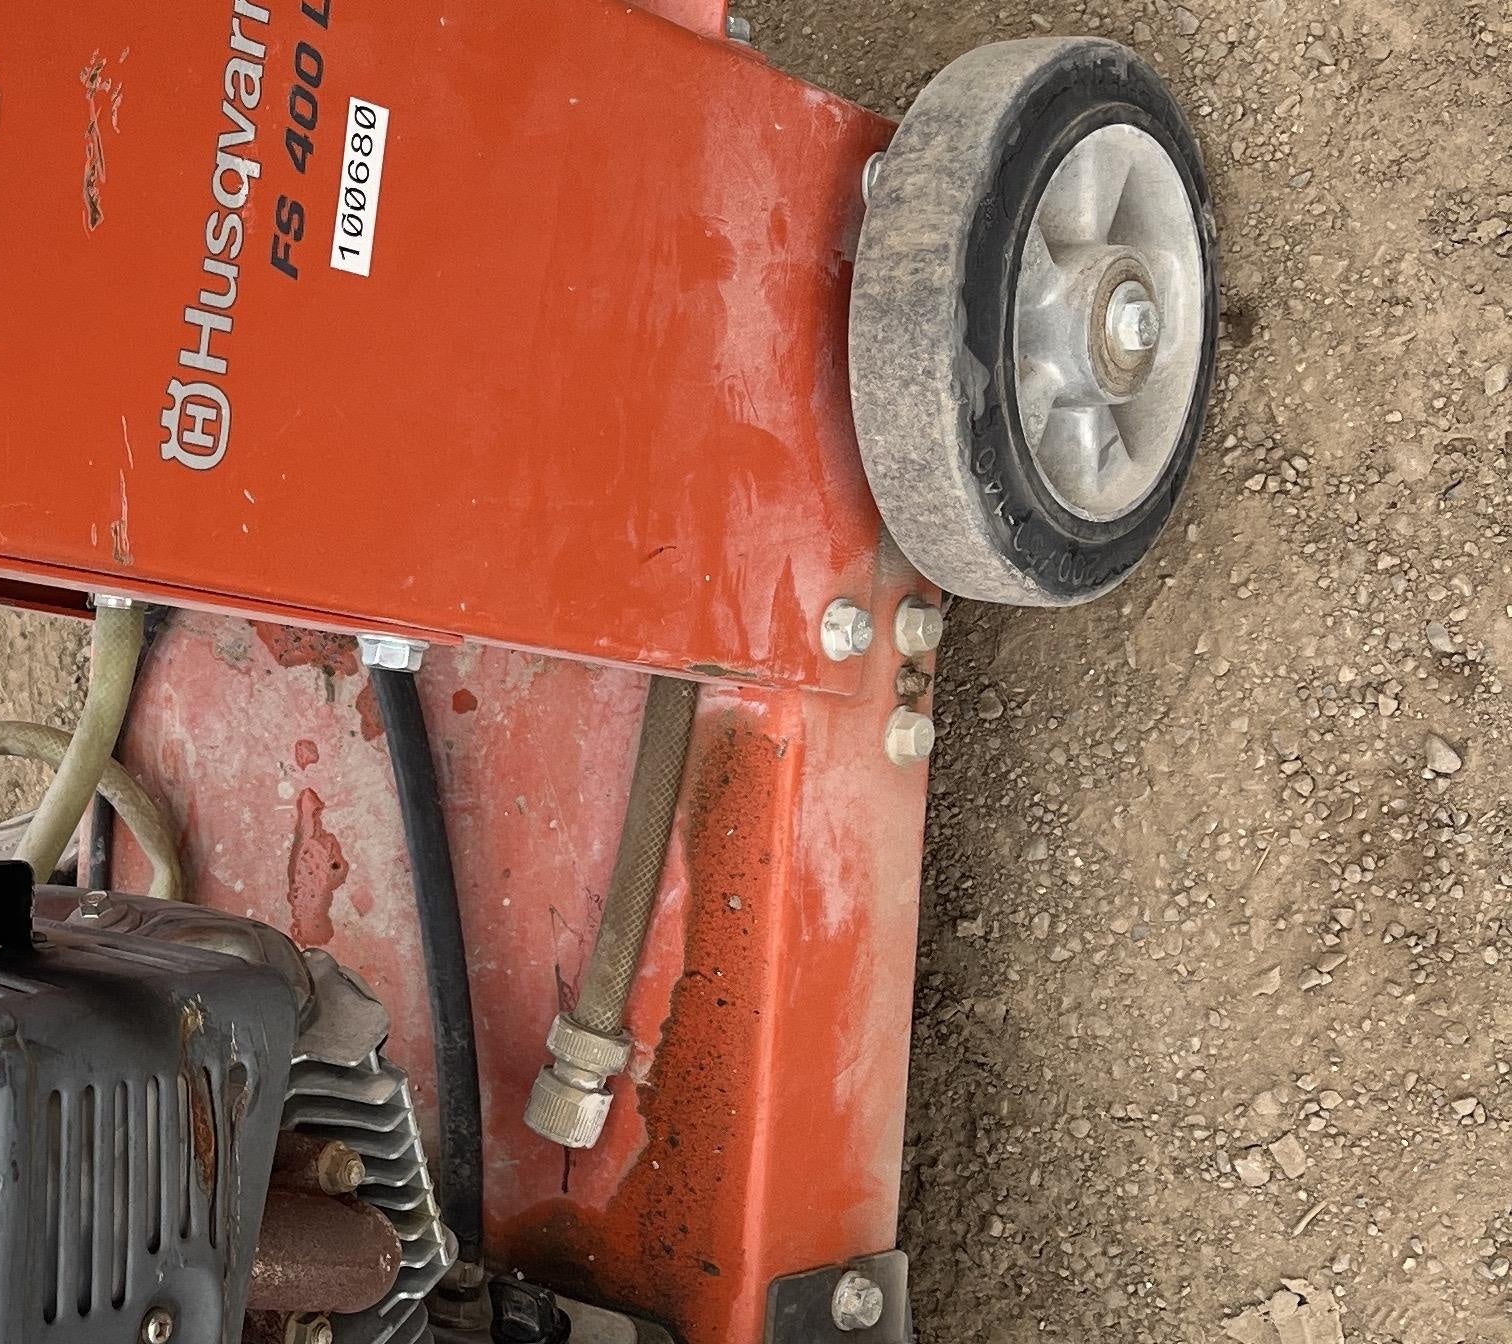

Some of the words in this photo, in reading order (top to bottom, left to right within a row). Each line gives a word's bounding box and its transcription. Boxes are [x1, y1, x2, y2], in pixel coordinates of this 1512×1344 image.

[285, 40, 326, 173] 400
[270, 194, 305, 281] FS
[338, 105, 378, 259] 100680
